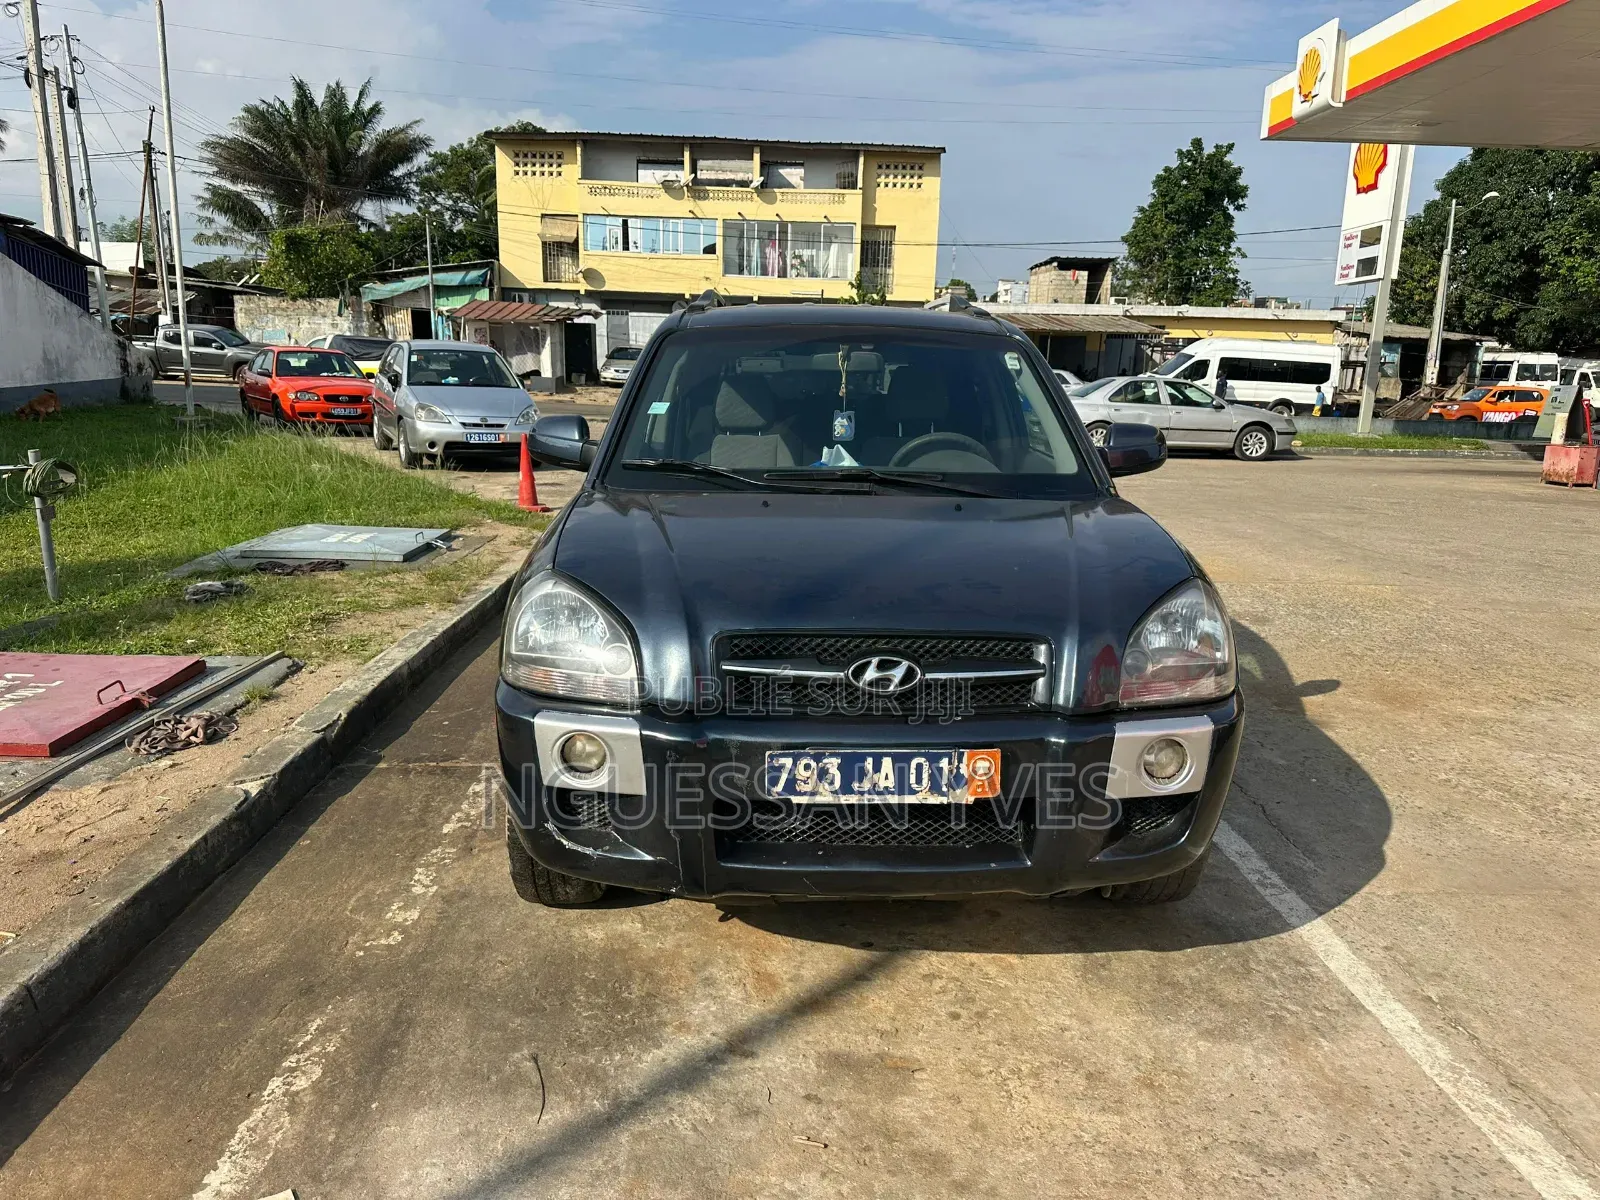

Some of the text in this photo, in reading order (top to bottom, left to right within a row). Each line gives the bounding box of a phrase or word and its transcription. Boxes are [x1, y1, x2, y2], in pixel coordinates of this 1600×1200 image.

[772, 756, 950, 792] 793 JA 01
